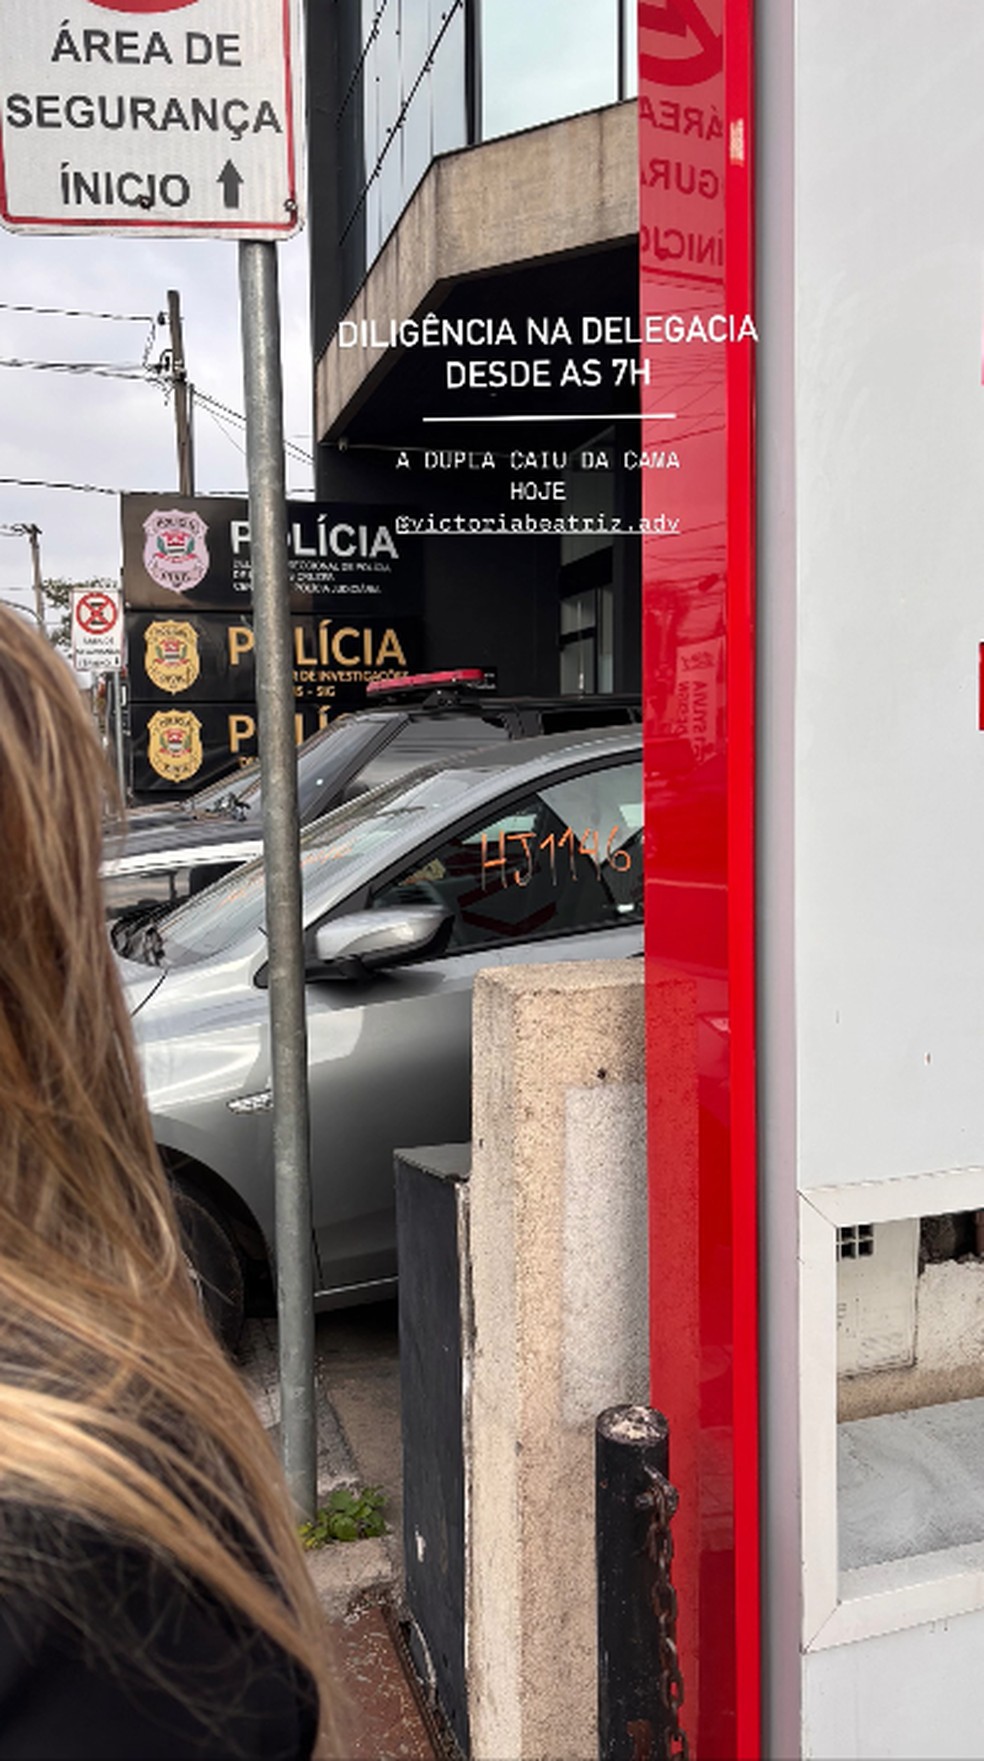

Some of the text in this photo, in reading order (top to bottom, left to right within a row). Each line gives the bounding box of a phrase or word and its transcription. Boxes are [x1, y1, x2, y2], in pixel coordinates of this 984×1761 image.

[51, 19, 242, 67] ÁREA DE
[6, 93, 283, 141] SEGURANÇA
[230, 514, 399, 559] PLÍCIA
[228, 619, 407, 666] PLÍCIA
[481, 825, 632, 892] HJ1146
